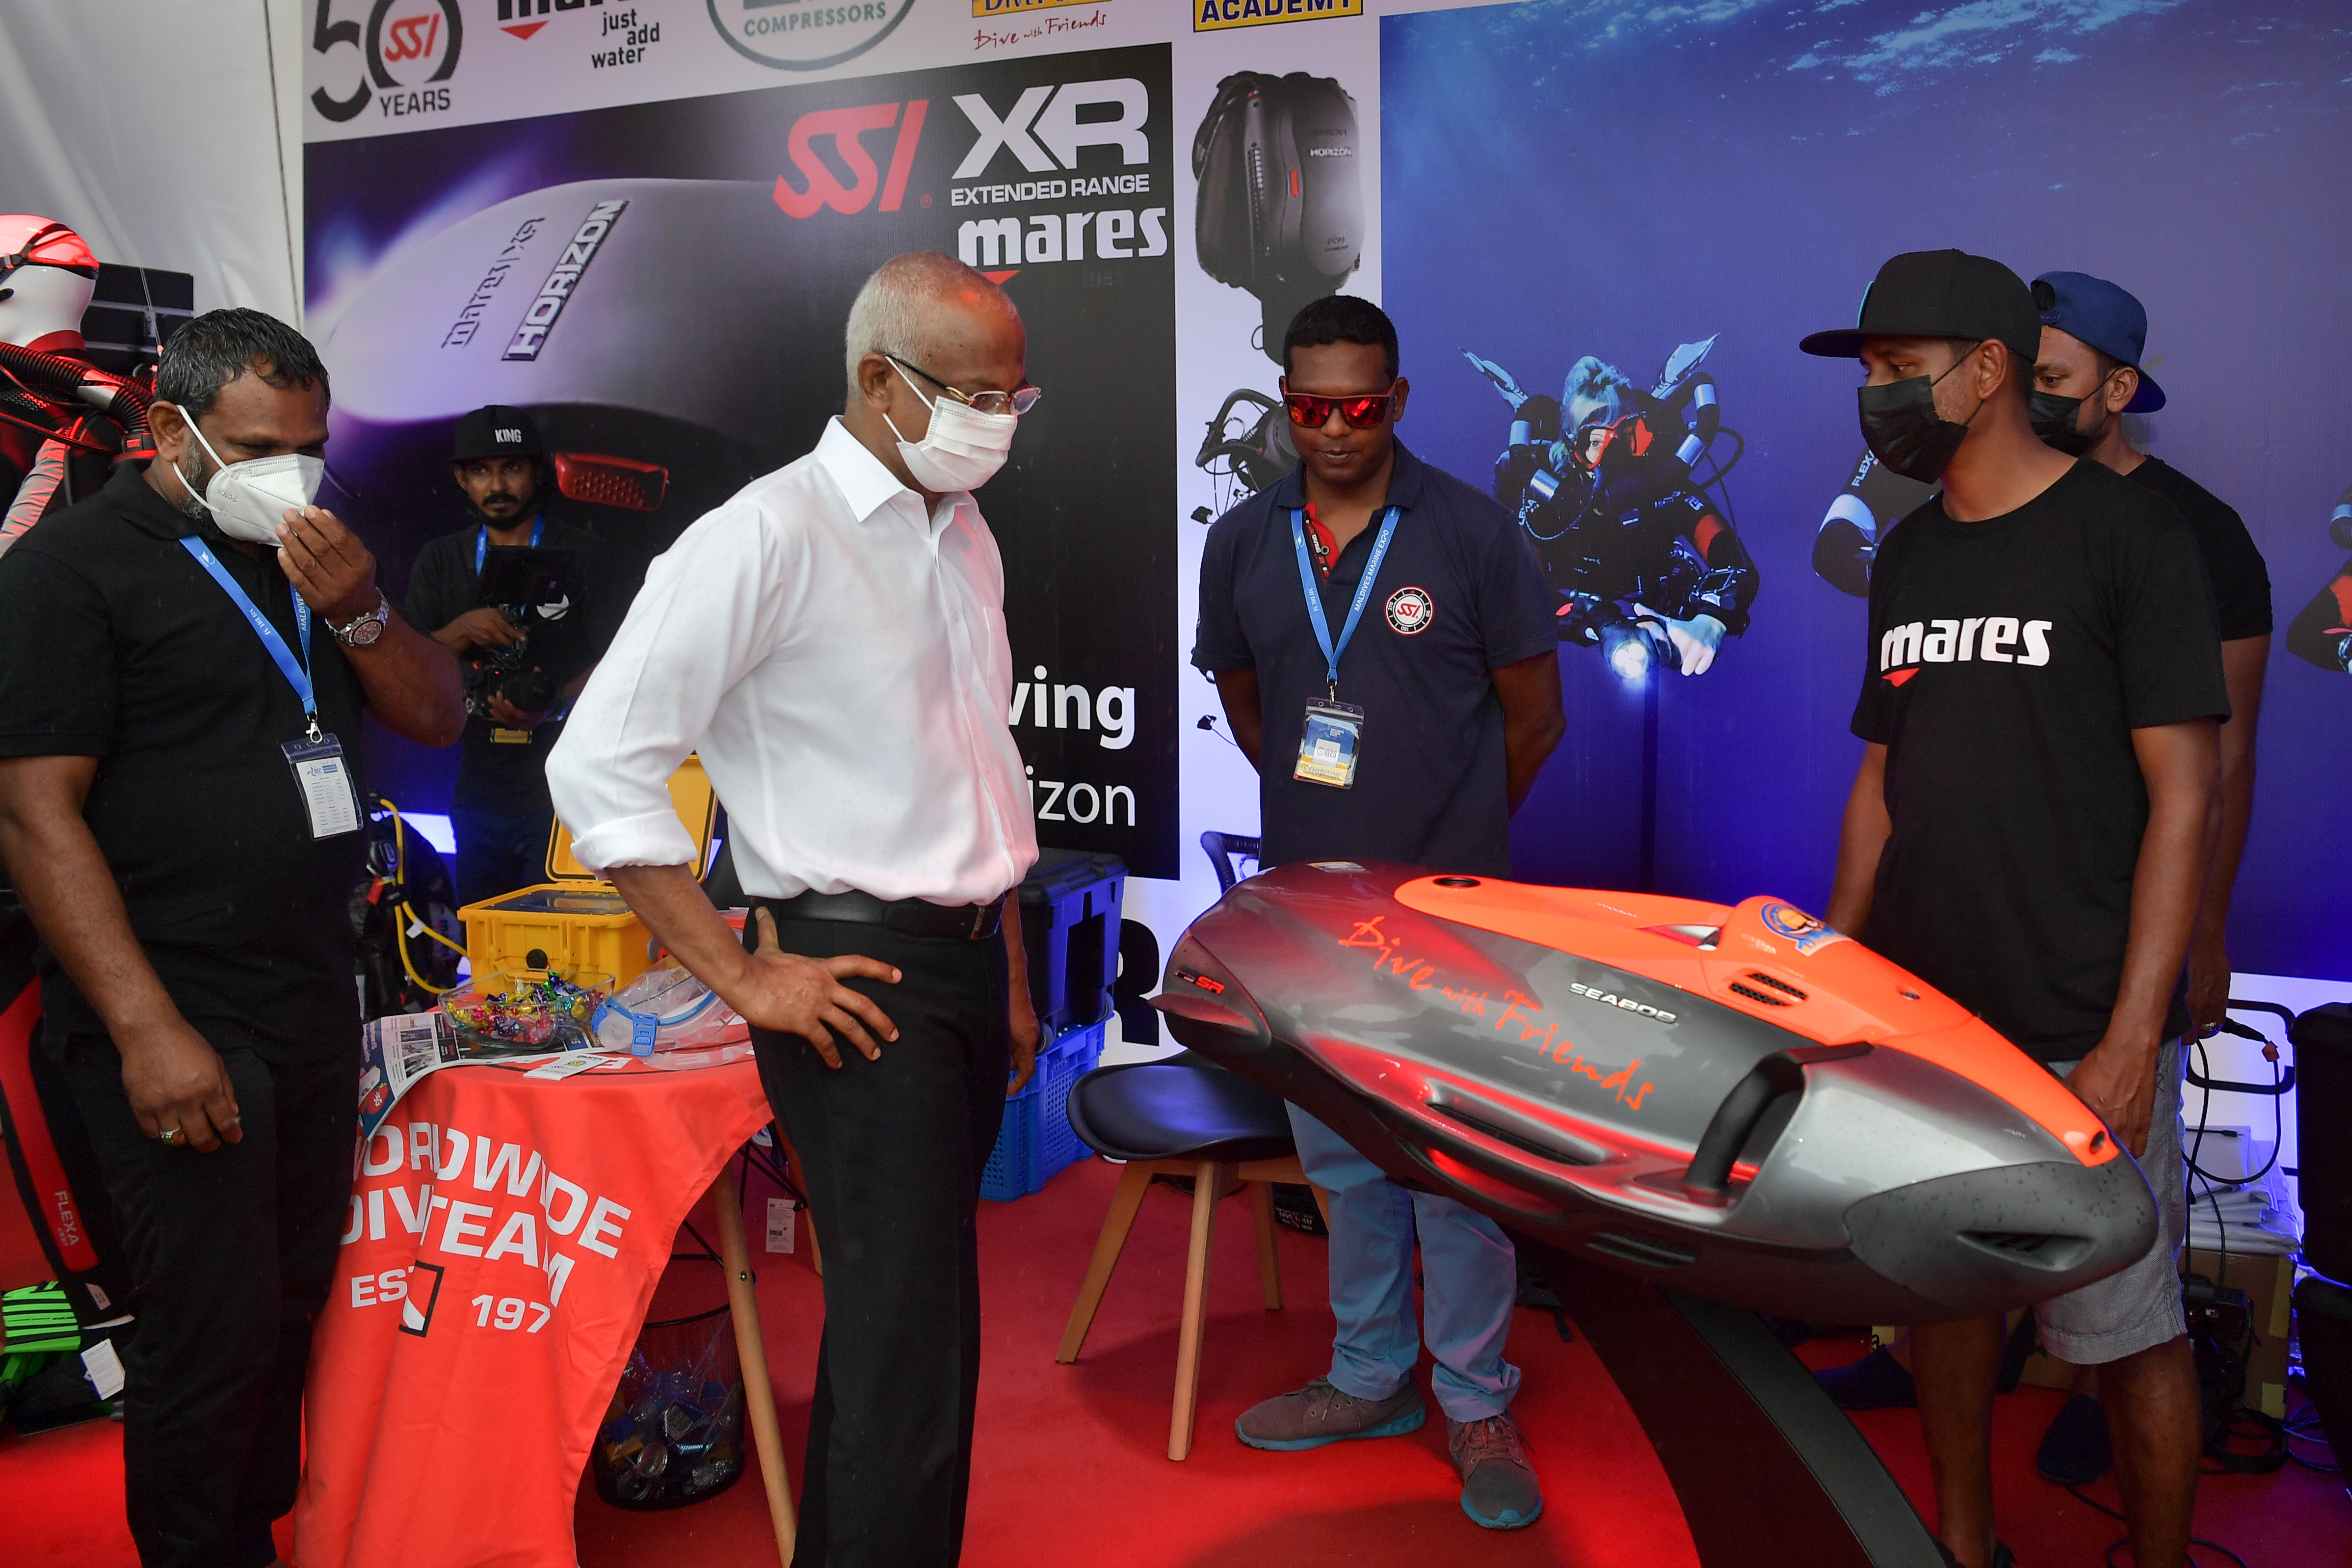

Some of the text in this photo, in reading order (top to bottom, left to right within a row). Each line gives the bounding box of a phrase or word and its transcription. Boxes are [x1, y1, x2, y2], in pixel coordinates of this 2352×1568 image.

[384, 13, 440, 62] SSI
[602, 8, 637, 36] just
[627, 22, 660, 46] add
[744, 2, 886, 37] COMPRESSORS
[974, 9, 1107, 50] Dive with Friends
[591, 48, 645, 69] water
[379, 88, 450, 118] YEARS
[951, 78, 1150, 180] XR
[773, 99, 929, 219] SSI
[951, 174, 1150, 207] EXTENDED RANGE
[958, 207, 1167, 267] mares
[507, 200, 625, 357] HORIZON
[494, 428, 522, 443] KING
[1312, 533, 1321, 554] DIVING
[1354, 529, 1389, 612] MALDIVES MARINE EXPO
[1397, 603, 1421, 618] SSI
[1880, 616, 2053, 672] mares
[1303, 766, 1340, 779] EXHIBITOR
[1325, 748, 1337, 757] WPS
[1338, 915, 1654, 1111] Dive with Friends
[1568, 982, 1677, 1024] SEABOB
[55, 1190, 80, 1247] FLEXA
[351, 1266, 415, 1308] ES
